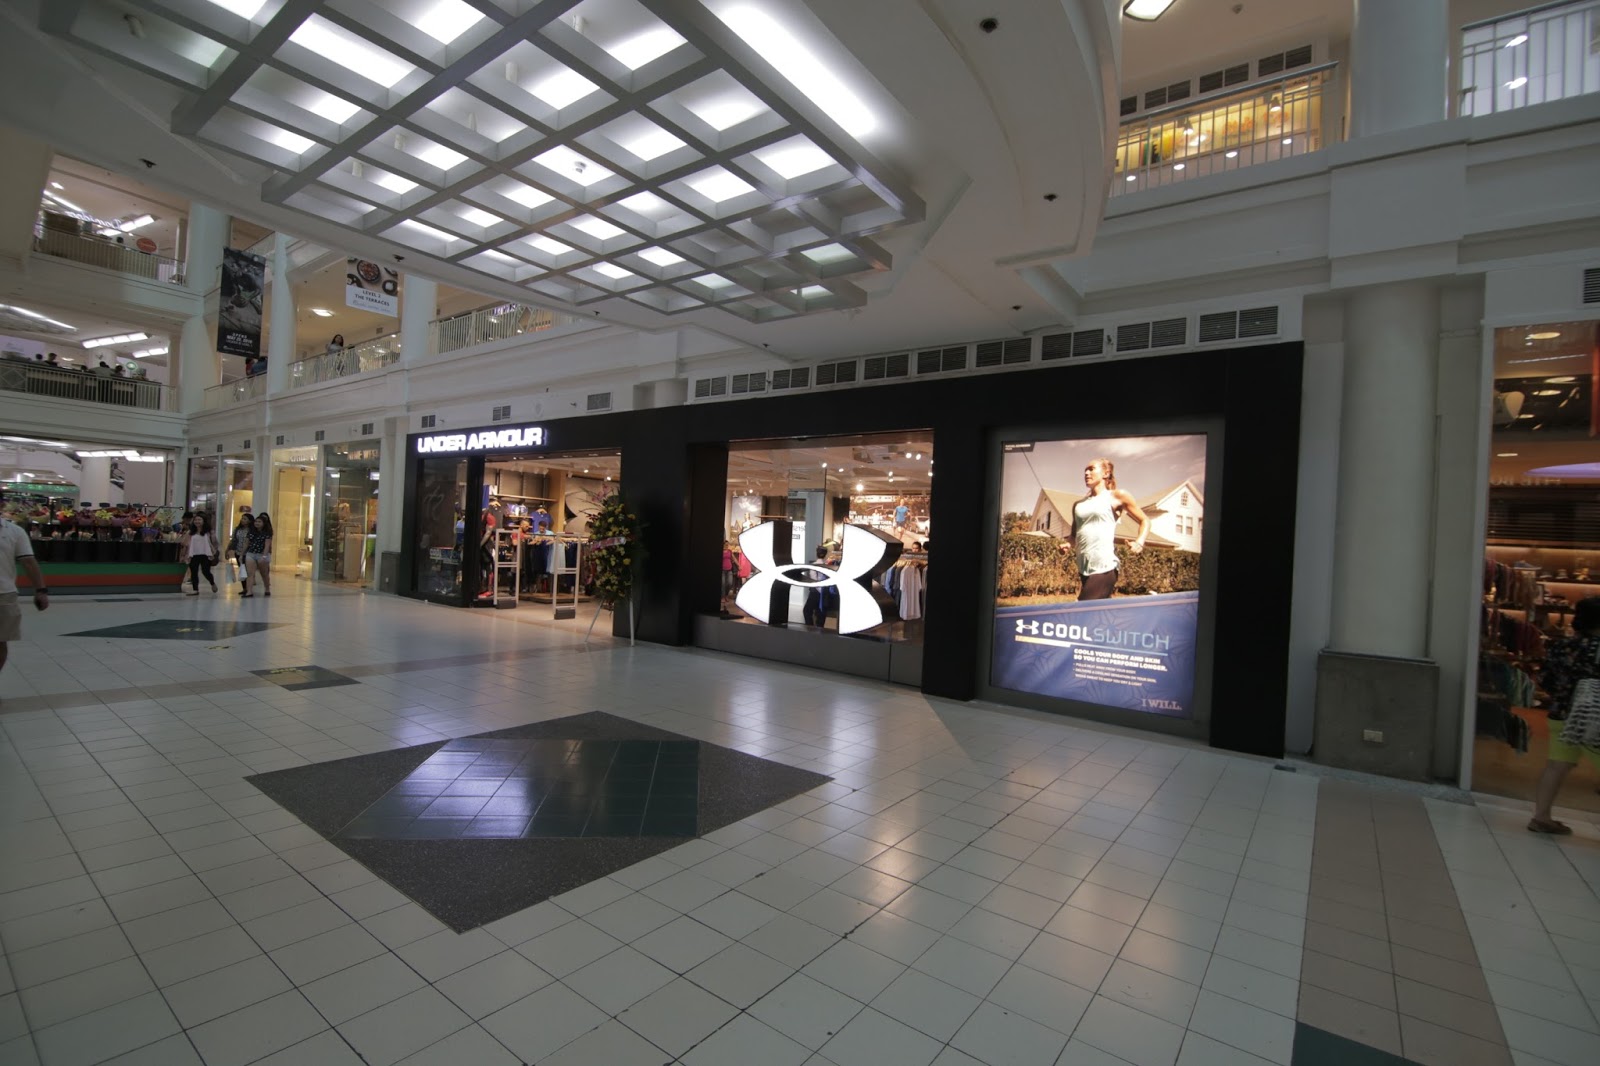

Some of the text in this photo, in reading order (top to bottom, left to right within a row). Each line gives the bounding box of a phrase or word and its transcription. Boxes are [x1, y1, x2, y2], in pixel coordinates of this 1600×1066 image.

[366, 296, 390, 306] TERRACES
[417, 426, 543, 453] UNDER ARMOUR
[1110, 659, 1139, 667] PERFORM
[1140, 663, 1168, 672] LONGER.
